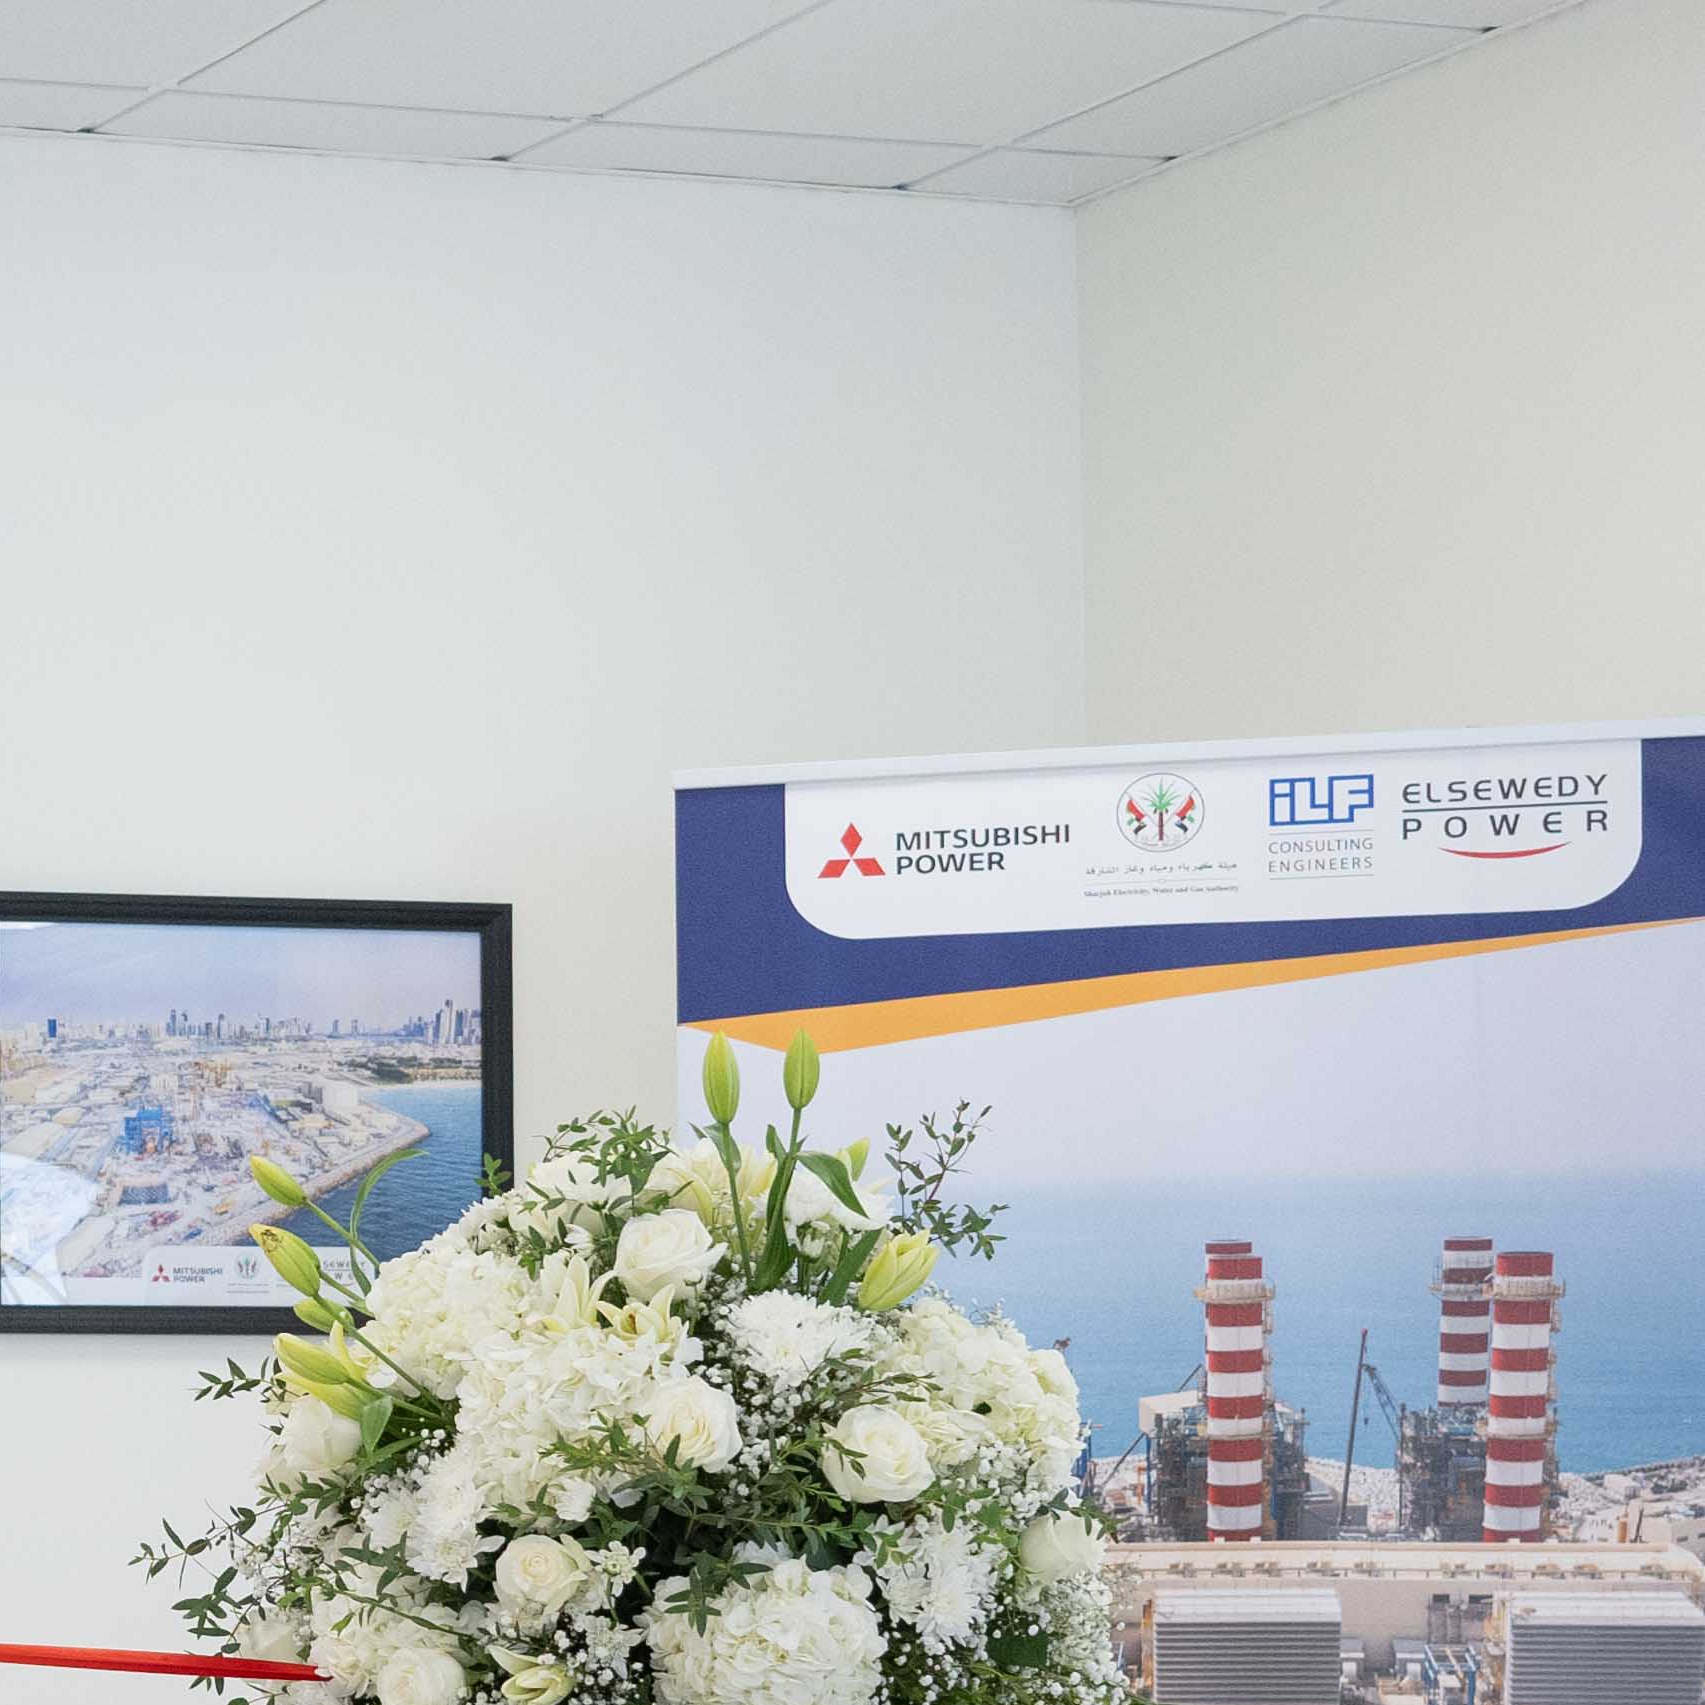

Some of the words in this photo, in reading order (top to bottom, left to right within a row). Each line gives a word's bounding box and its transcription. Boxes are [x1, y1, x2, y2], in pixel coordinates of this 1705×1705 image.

[1402, 774, 1607, 804] ELSEWEDY
[1402, 809, 1608, 840] POWER
[896, 823, 1070, 851] MITSUBISHI
[1268, 837, 1373, 854] CONSULTING
[896, 851, 1005, 875] POWER
[1268, 857, 1373, 873] ENGINEERS
[172, 1266, 223, 1276] MITSUBISHI
[173, 1275, 206, 1284] POWER
